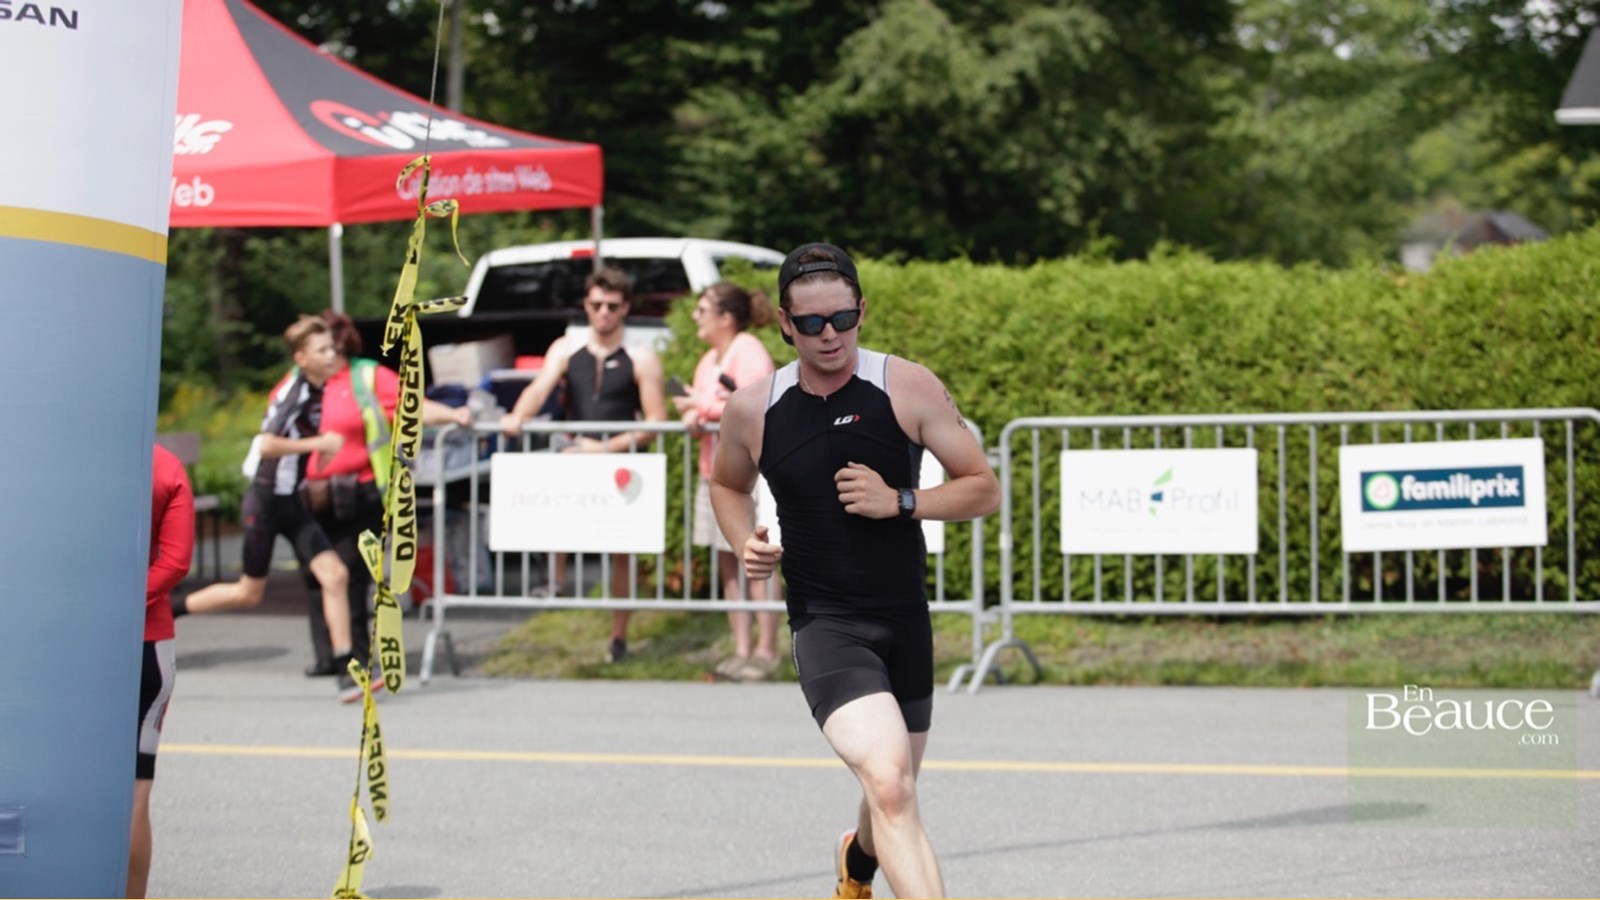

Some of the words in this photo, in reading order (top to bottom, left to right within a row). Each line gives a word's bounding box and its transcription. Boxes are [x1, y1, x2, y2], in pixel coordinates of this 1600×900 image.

[171, 176, 215, 207] eb
[1080, 488, 1142, 513] MAB
[1171, 486, 1239, 514] Profil
[1402, 473, 1520, 506] familiprix
